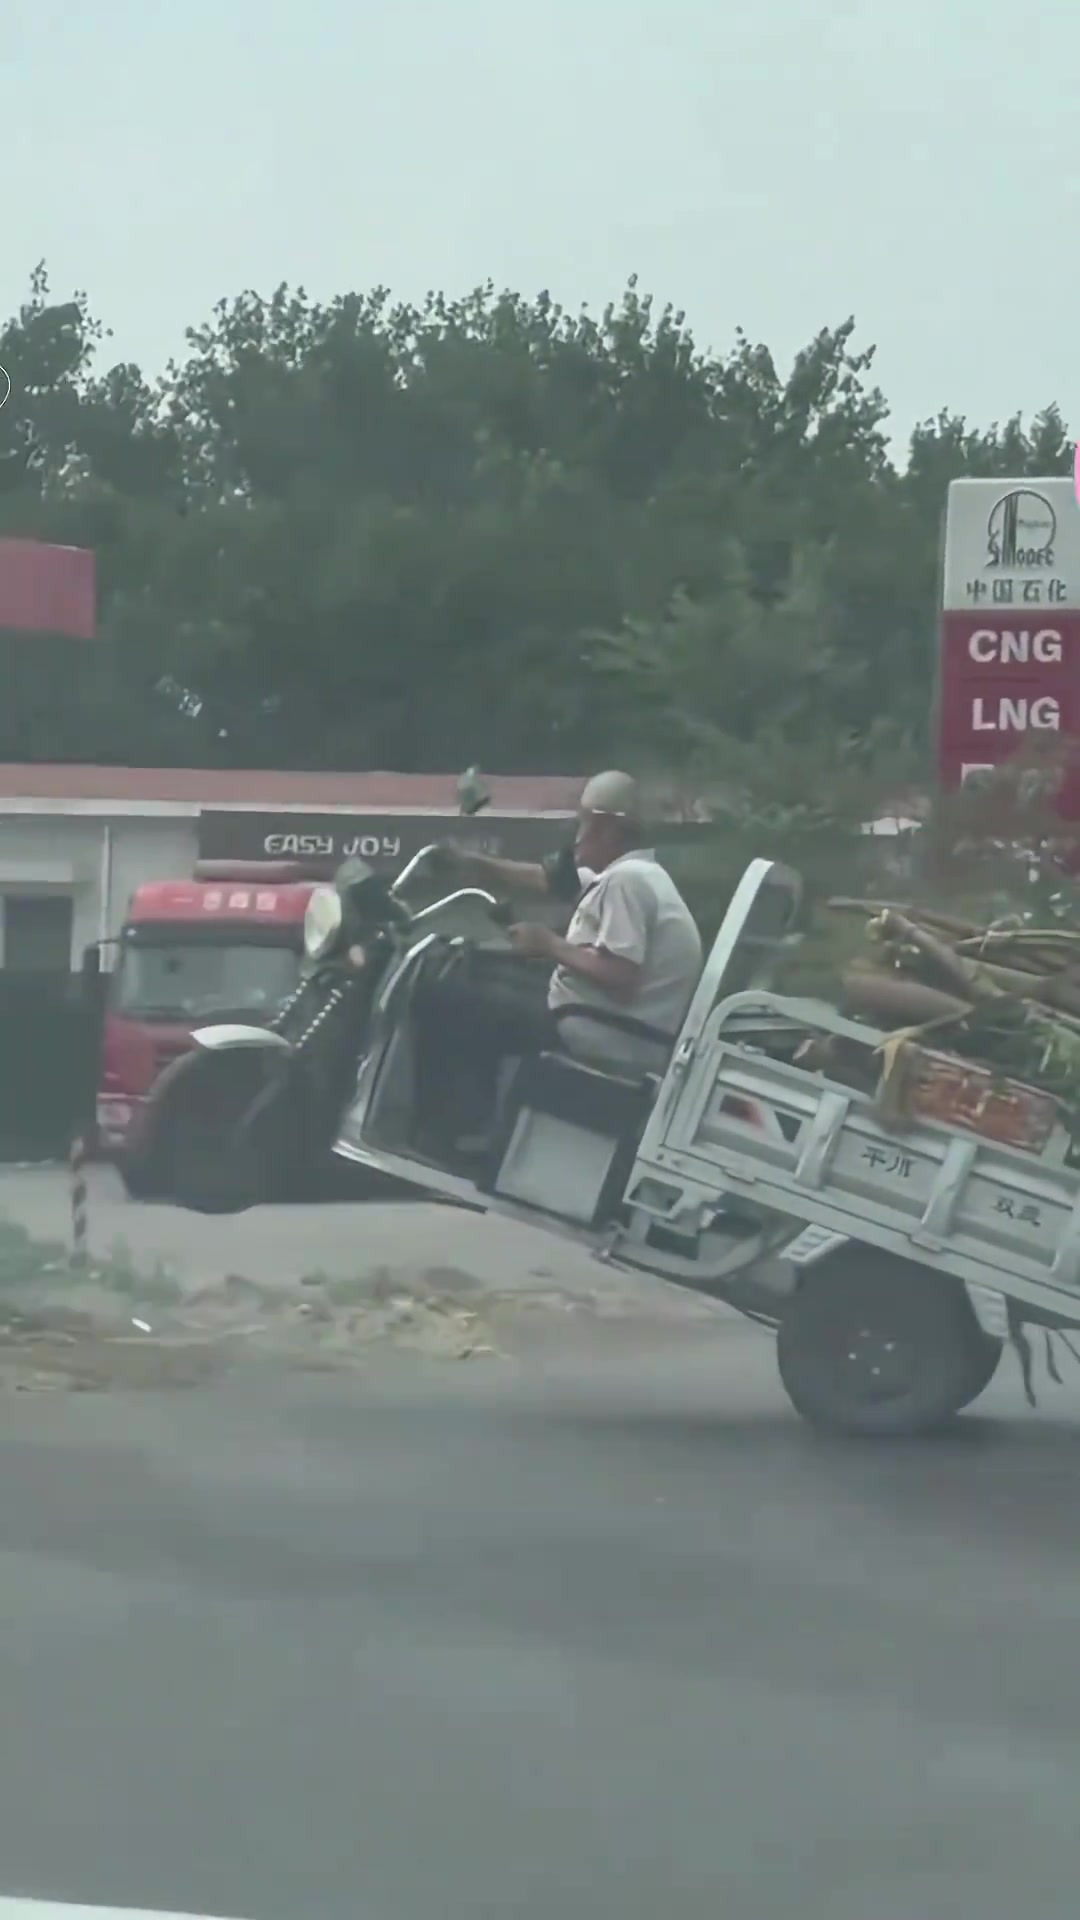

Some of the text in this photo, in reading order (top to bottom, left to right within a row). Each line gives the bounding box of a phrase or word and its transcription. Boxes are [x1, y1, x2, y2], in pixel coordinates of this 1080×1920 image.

[966, 578, 1067, 604] 中国石化
[968, 629, 1063, 664] CNG
[972, 696, 1060, 731] LNG
[264, 834, 400, 856] EASY JOY
